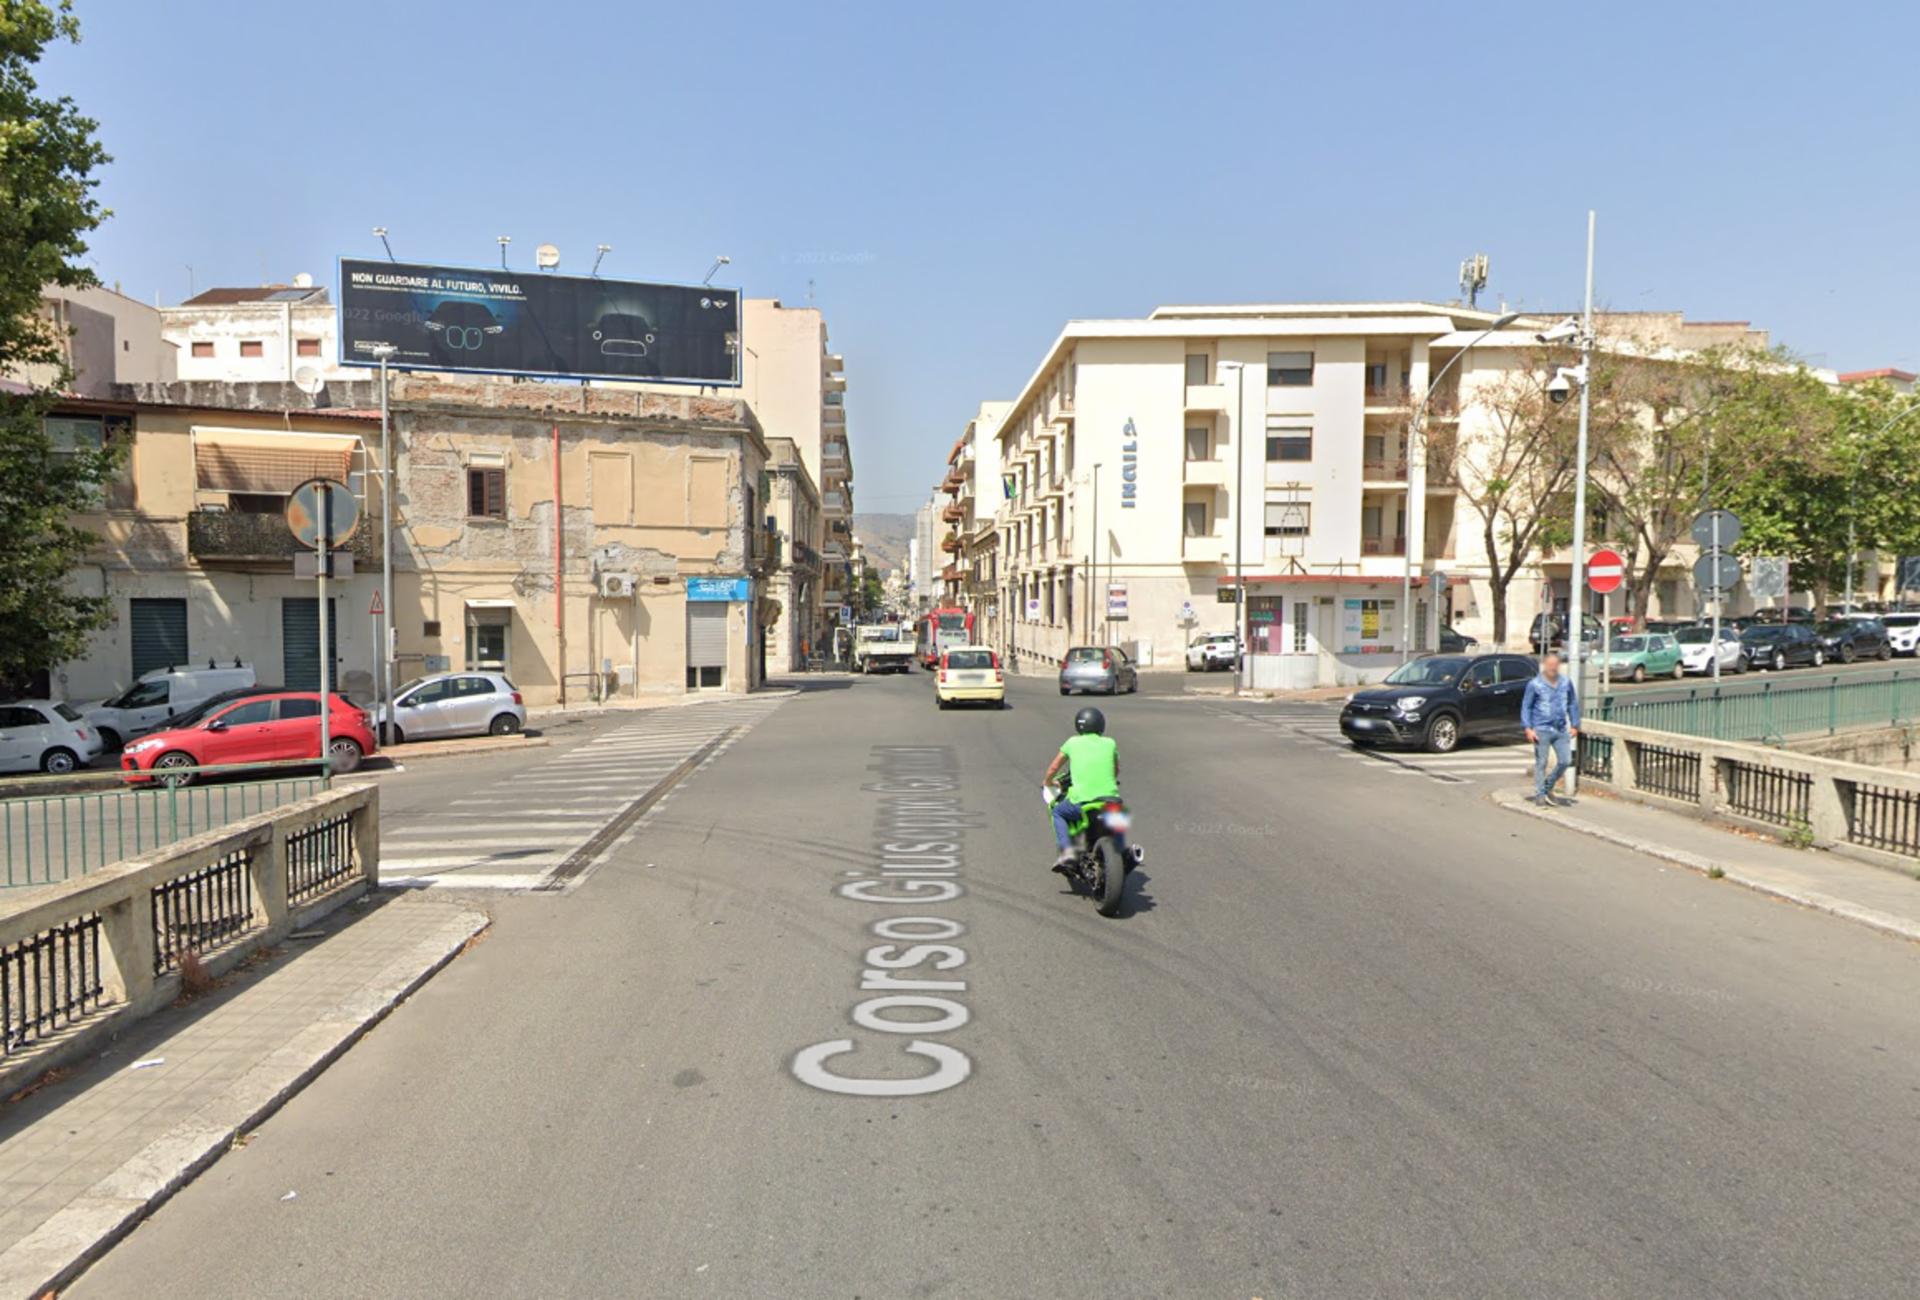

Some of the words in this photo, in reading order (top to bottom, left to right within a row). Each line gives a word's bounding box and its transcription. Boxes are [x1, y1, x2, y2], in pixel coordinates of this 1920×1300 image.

[352, 272, 373, 283] NON
[375, 274, 428, 288] GUARDARE
[431, 279, 445, 289] AL
[446, 280, 487, 294] FUTURO,
[488, 283, 522, 294] VIVILO.
